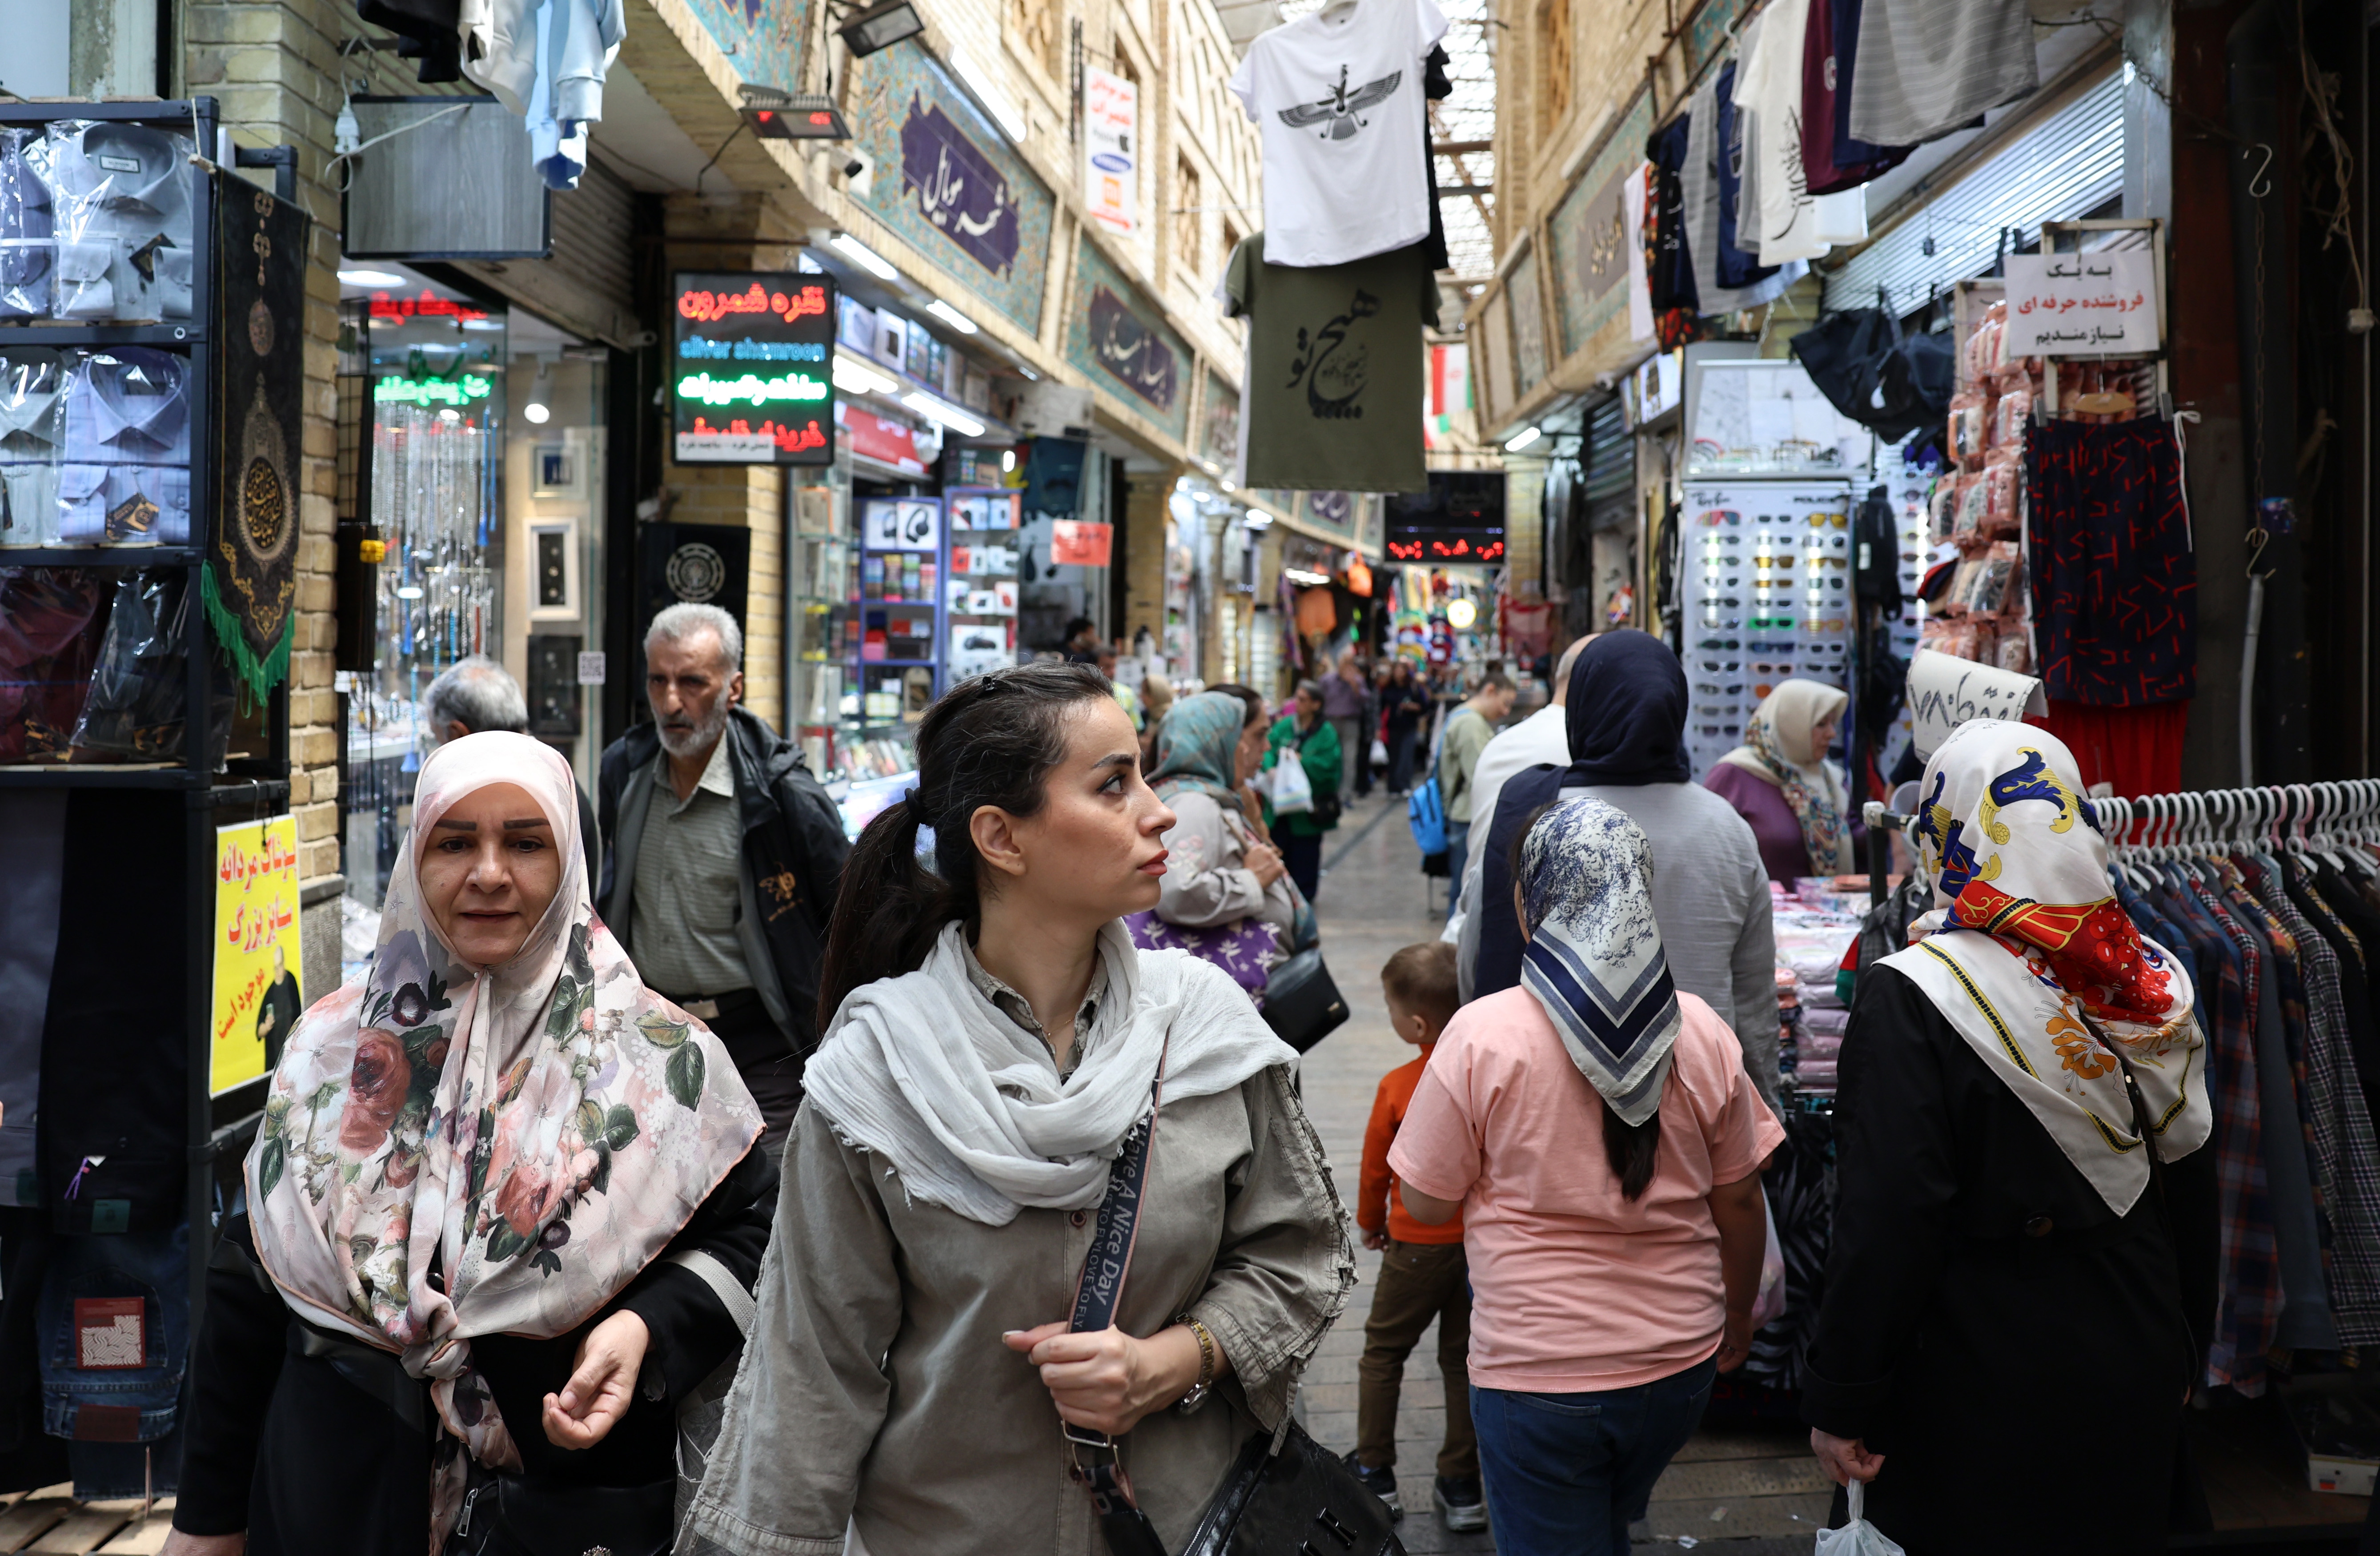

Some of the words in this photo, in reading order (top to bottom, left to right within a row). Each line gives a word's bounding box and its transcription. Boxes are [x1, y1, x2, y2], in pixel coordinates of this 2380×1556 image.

[2047, 263, 2082, 281] یک
[2086, 265, 2112, 282] به
[678, 281, 768, 322] شمرون
[771, 286, 827, 322] نقره
[2018, 295, 2037, 315] ای
[2041, 293, 2077, 314] حرفه
[2082, 289, 2144, 312] فروشنده
[2035, 325, 2125, 346] نیازمندیم
[773, 420, 827, 452] خرید
[219, 840, 258, 891] مردانه
[228, 902, 264, 953] بزرگ
[265, 893, 293, 947] سایز
[237, 967, 265, 1012] موجود
[217, 997, 238, 1040] است
[1107, 1204, 1133, 1255] Nice
[1092, 1258, 1120, 1306] Day
[1074, 1306, 1087, 1328] FLY
